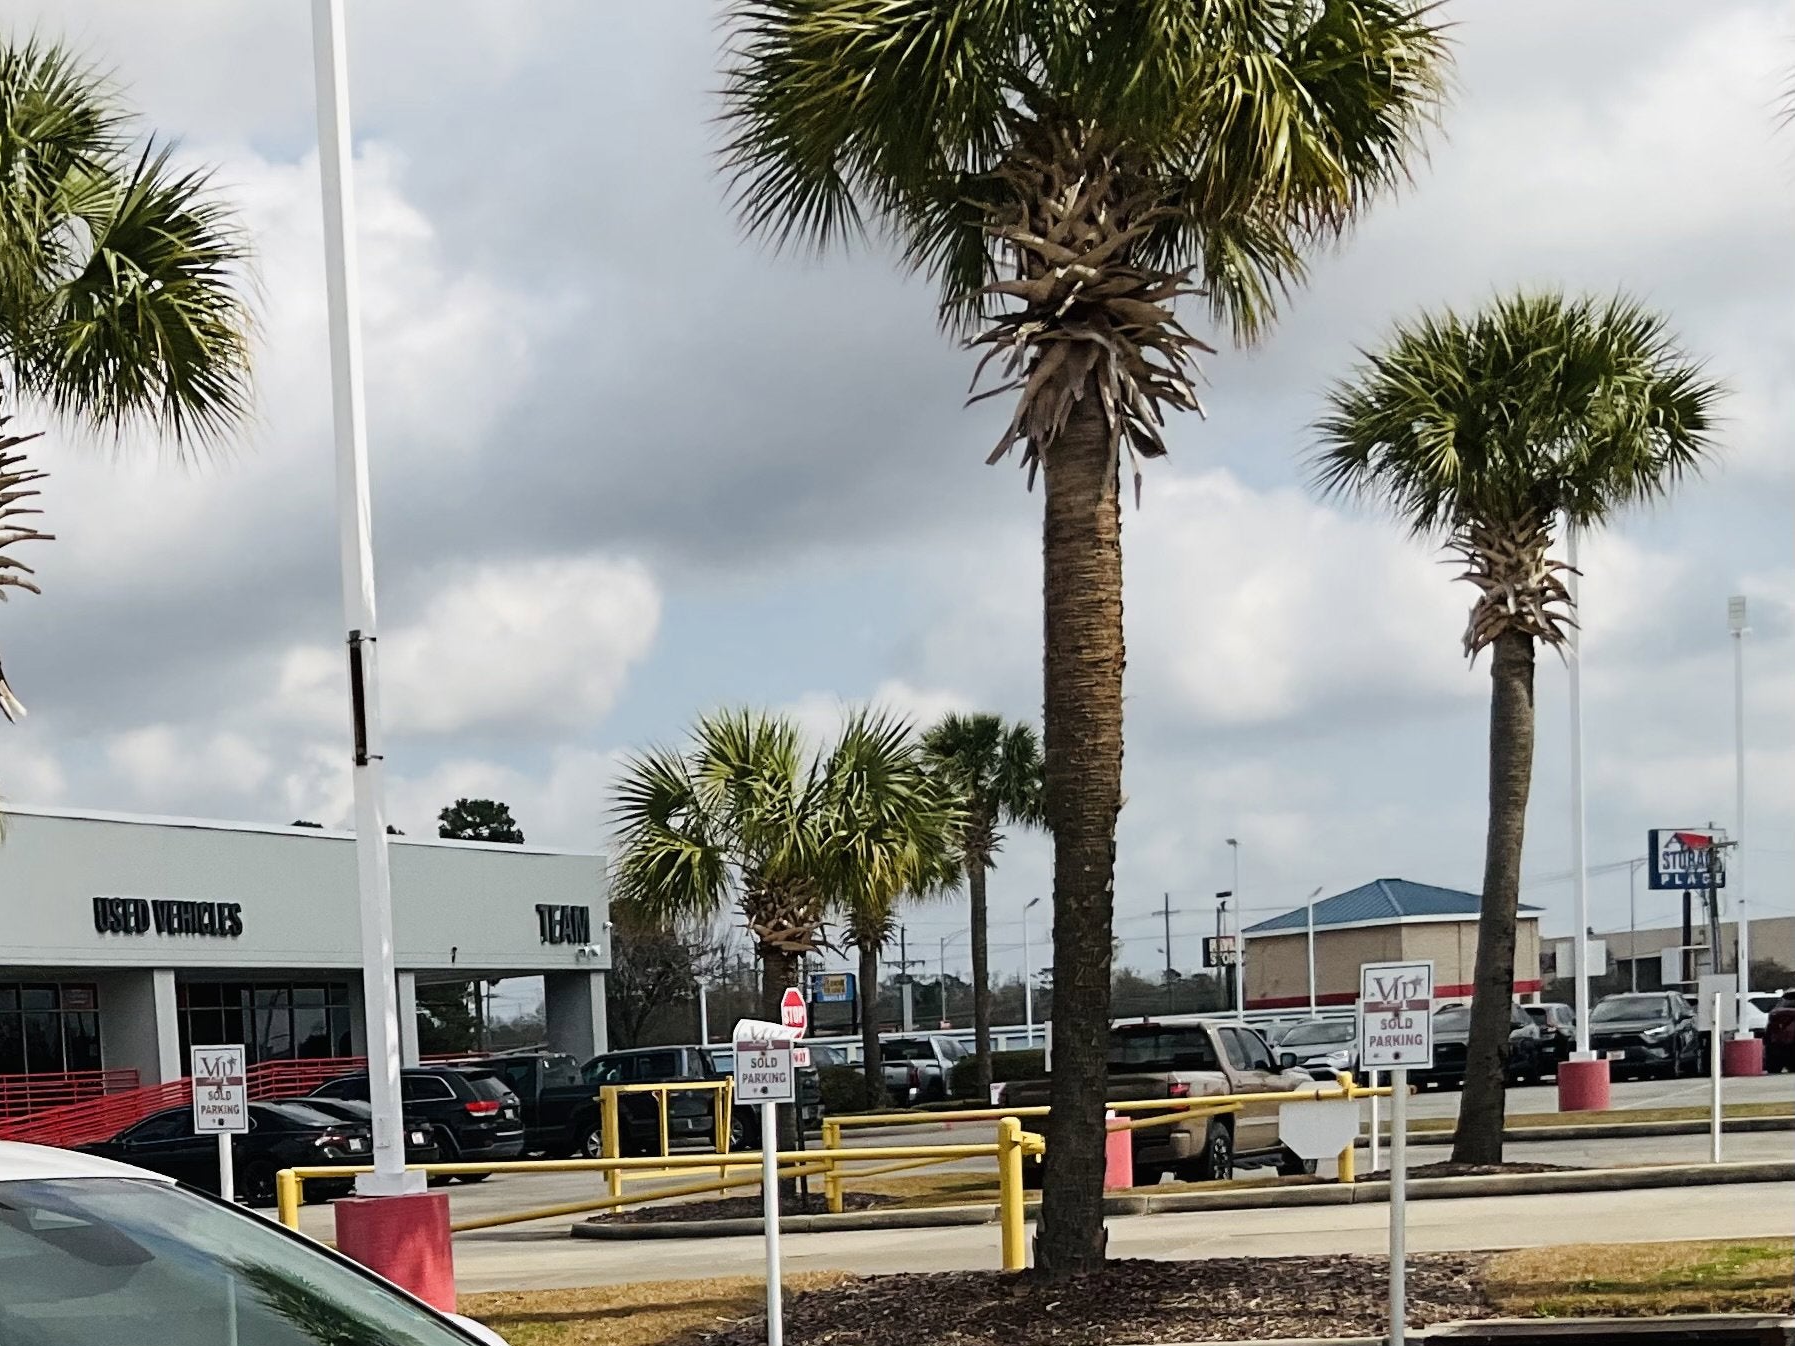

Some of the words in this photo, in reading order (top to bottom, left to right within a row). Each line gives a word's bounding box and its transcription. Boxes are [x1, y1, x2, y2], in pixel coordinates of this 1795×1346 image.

[1661, 873, 1723, 885] PLACE
[93, 897, 150, 935] USED
[151, 900, 243, 937] VEHICLES
[535, 904, 590, 945] TEAM
[1380, 1017, 1413, 1030] SOLD
[1369, 1034, 1423, 1047] PARKING
[751, 1057, 778, 1068] SOLD
[742, 1072, 786, 1084] PARKING
[208, 1091, 232, 1101] SOLD
[201, 1104, 240, 1115] PARKING
